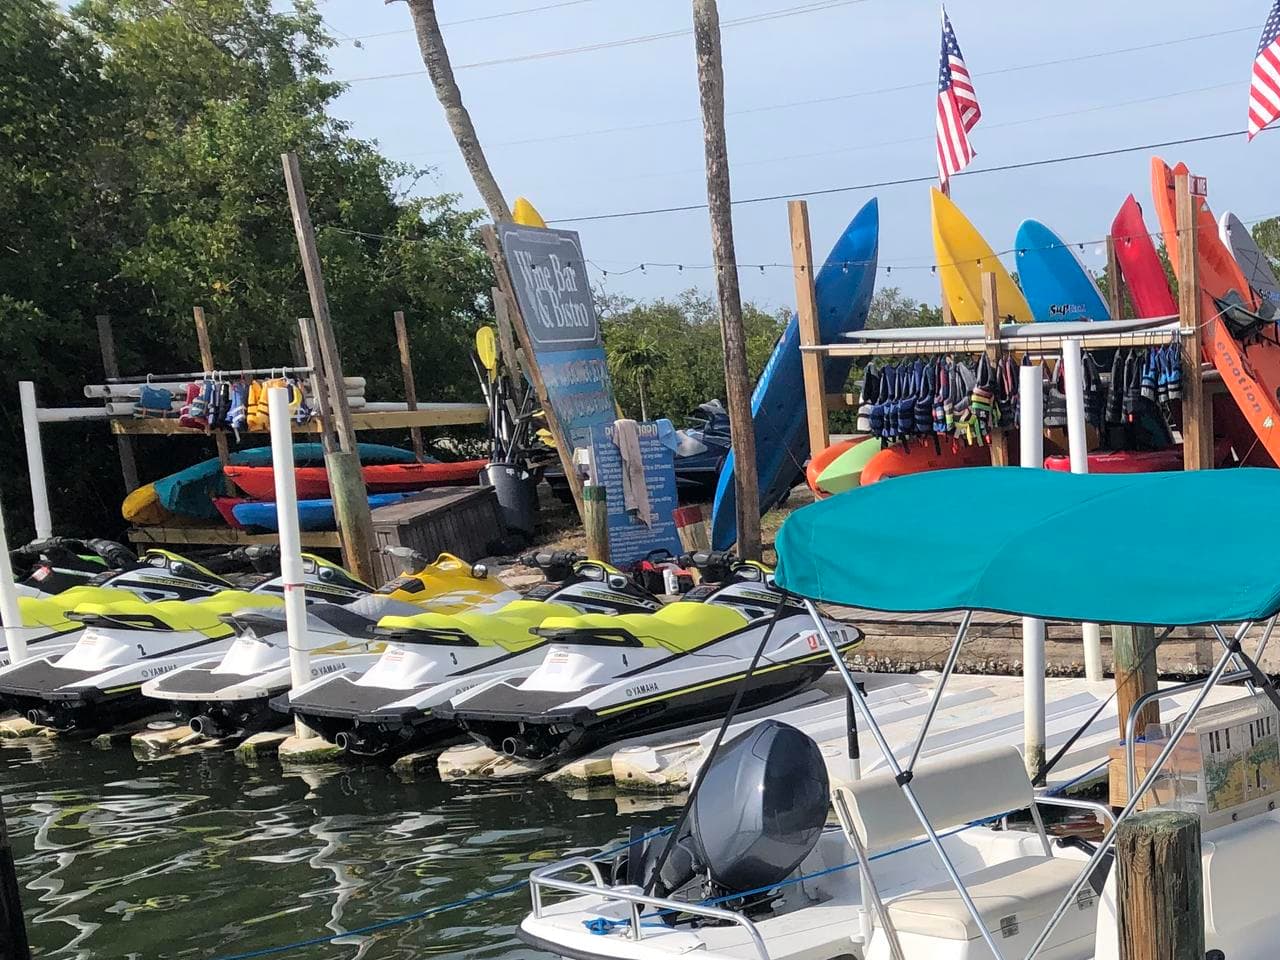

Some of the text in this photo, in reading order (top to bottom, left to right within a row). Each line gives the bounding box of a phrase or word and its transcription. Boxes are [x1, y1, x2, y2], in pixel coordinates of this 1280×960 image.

[513, 250, 578, 297] Wine Bar
[546, 287, 589, 328] Bistro
[1217, 342, 1261, 412] emotion
[137, 644, 147, 656] 2
[450, 652, 458, 666] 3
[622, 653, 628, 667] 4
[318, 662, 346, 675] YAMAHA
[632, 682, 659, 696] YAMAHA
